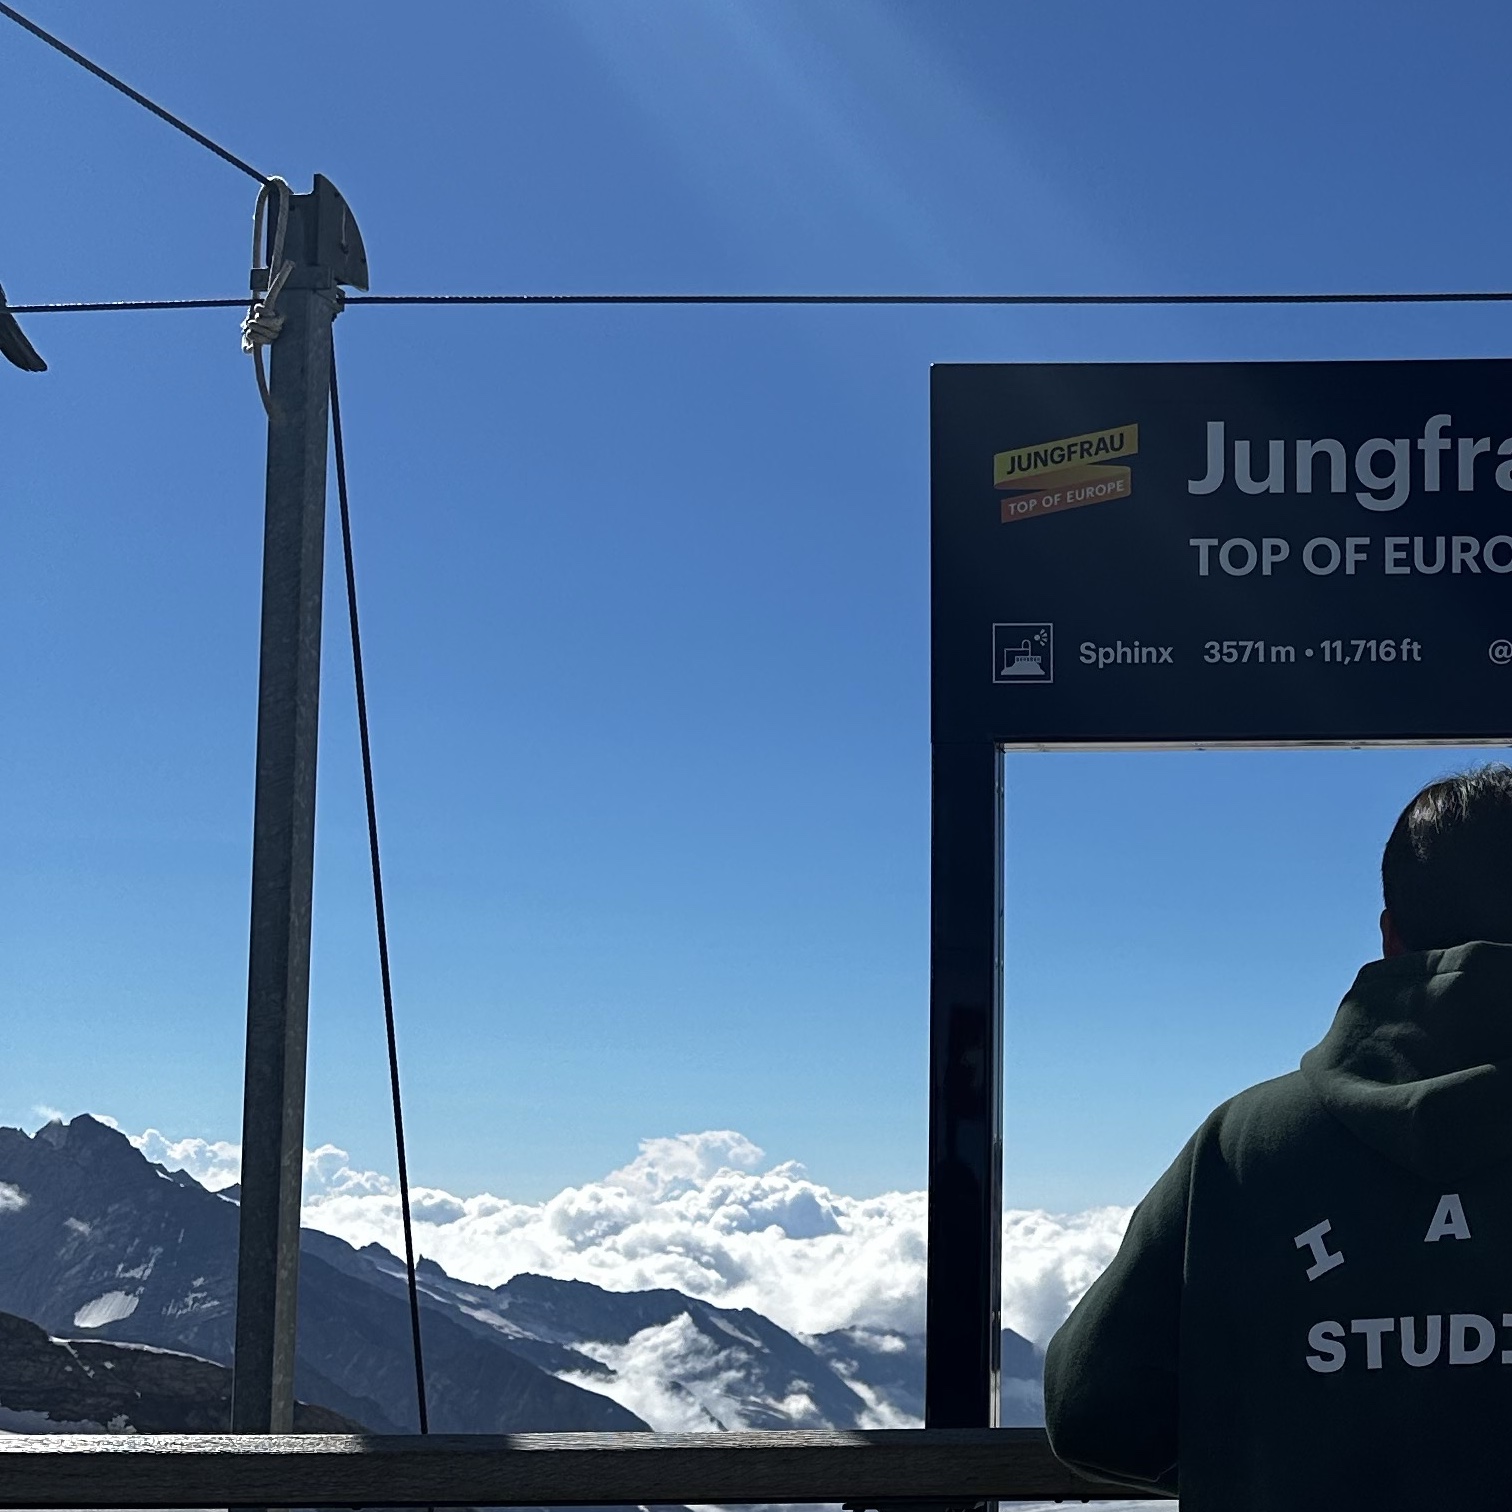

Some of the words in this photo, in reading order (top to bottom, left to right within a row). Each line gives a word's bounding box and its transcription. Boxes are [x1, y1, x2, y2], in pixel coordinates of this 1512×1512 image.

[1006, 432, 1125, 476] JUNGFRAU
[1008, 498, 1038, 516] TOP
[1041, 492, 1063, 509] OF
[1065, 480, 1126, 504] EUROPE
[1189, 538, 1290, 577] TOP
[1302, 537, 1370, 576] OF
[1078, 640, 1175, 670] Sphinx
